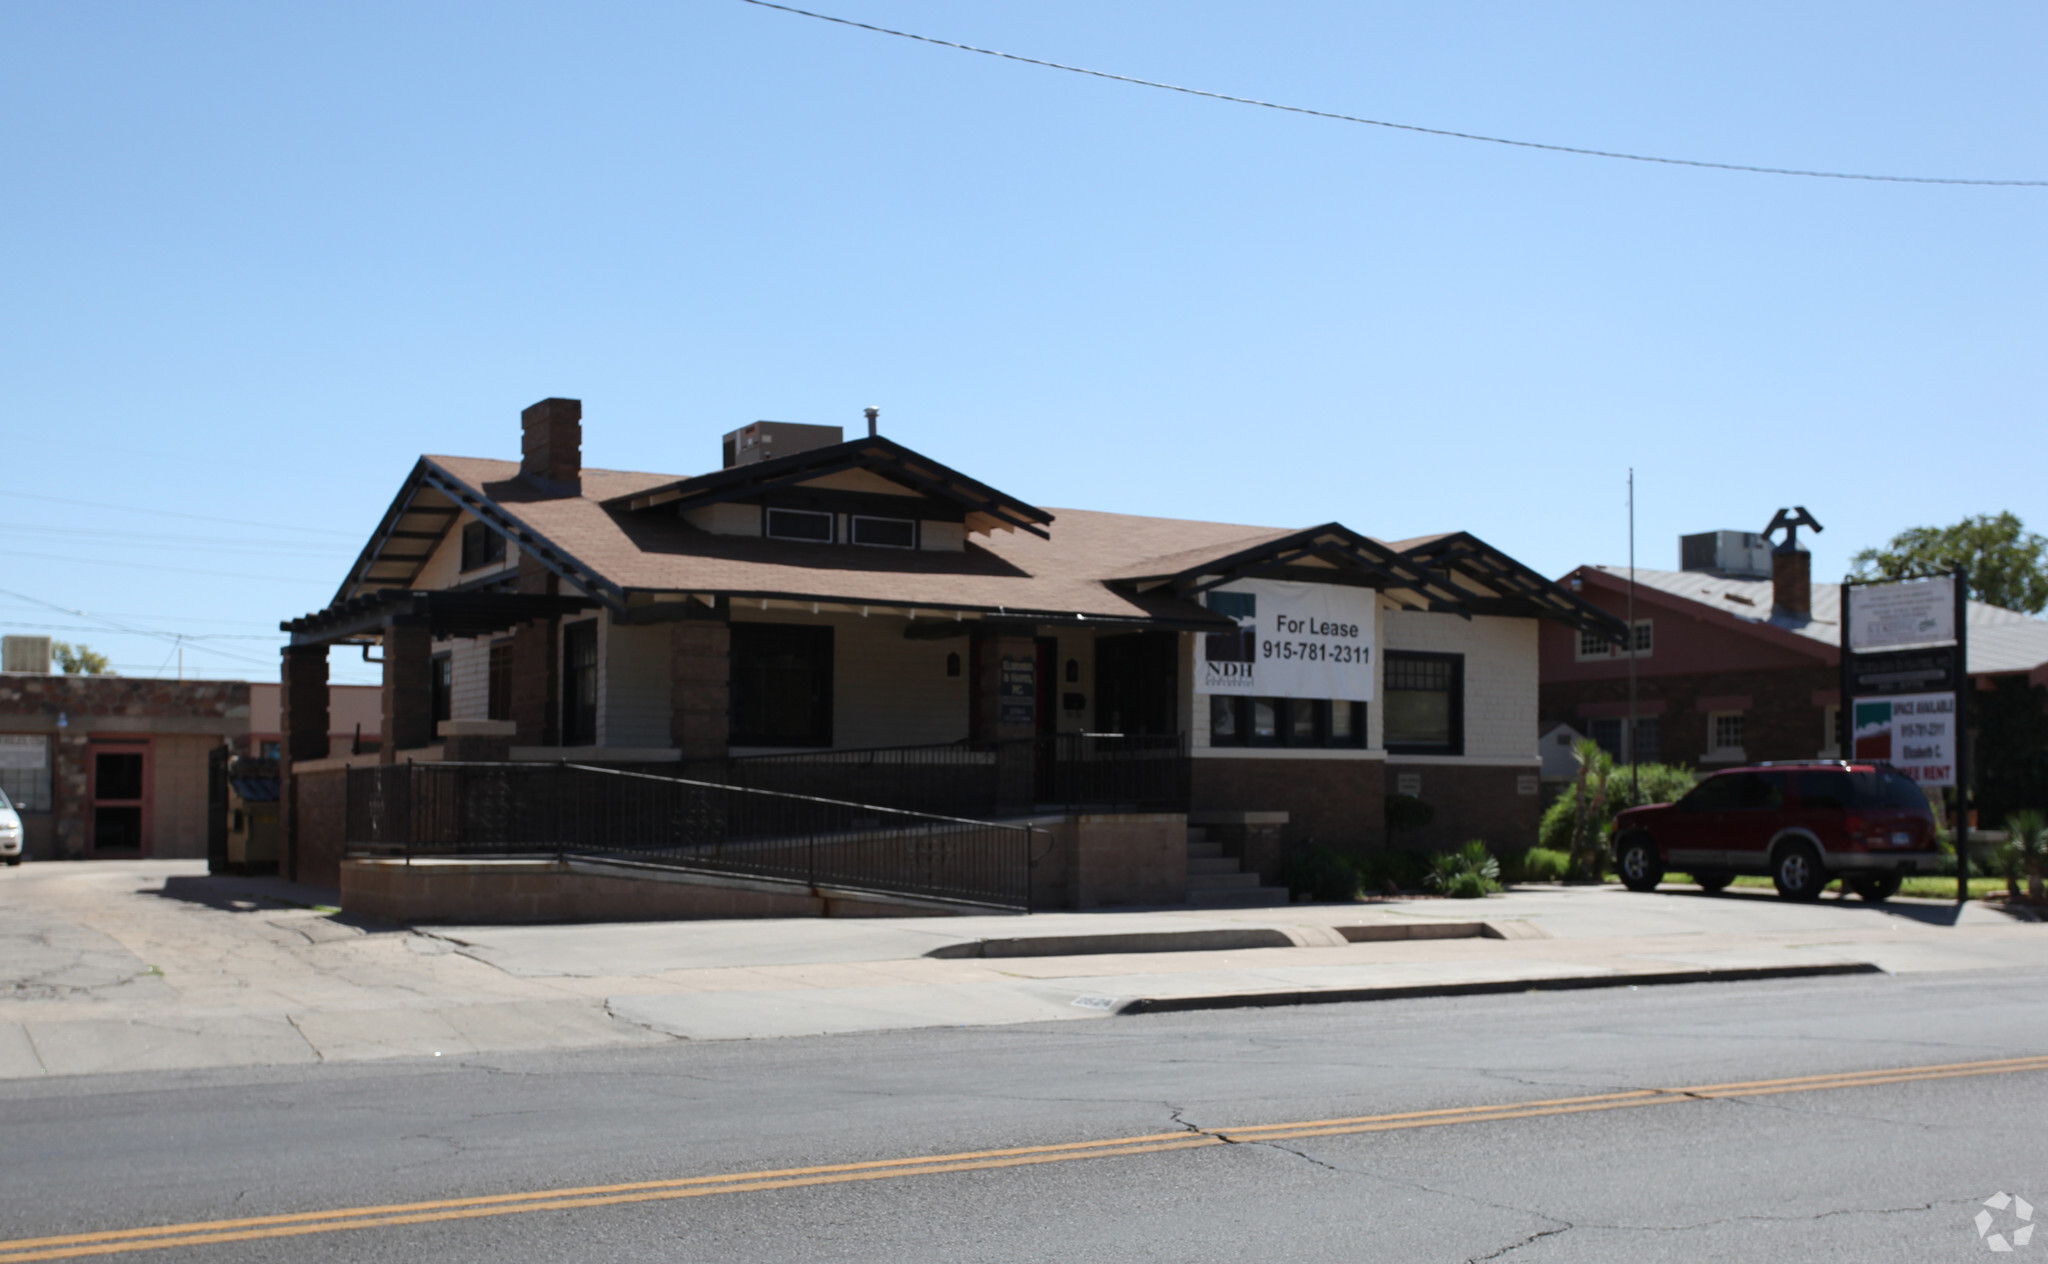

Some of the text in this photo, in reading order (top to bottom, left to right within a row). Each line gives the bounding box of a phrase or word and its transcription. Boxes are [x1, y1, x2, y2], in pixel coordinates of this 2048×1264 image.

[1276, 614, 1359, 638] For Lease
[1263, 641, 1369, 664] 915-781-2311
[1207, 662, 1253, 678] NDH
[1923, 765, 1950, 781] RENT
